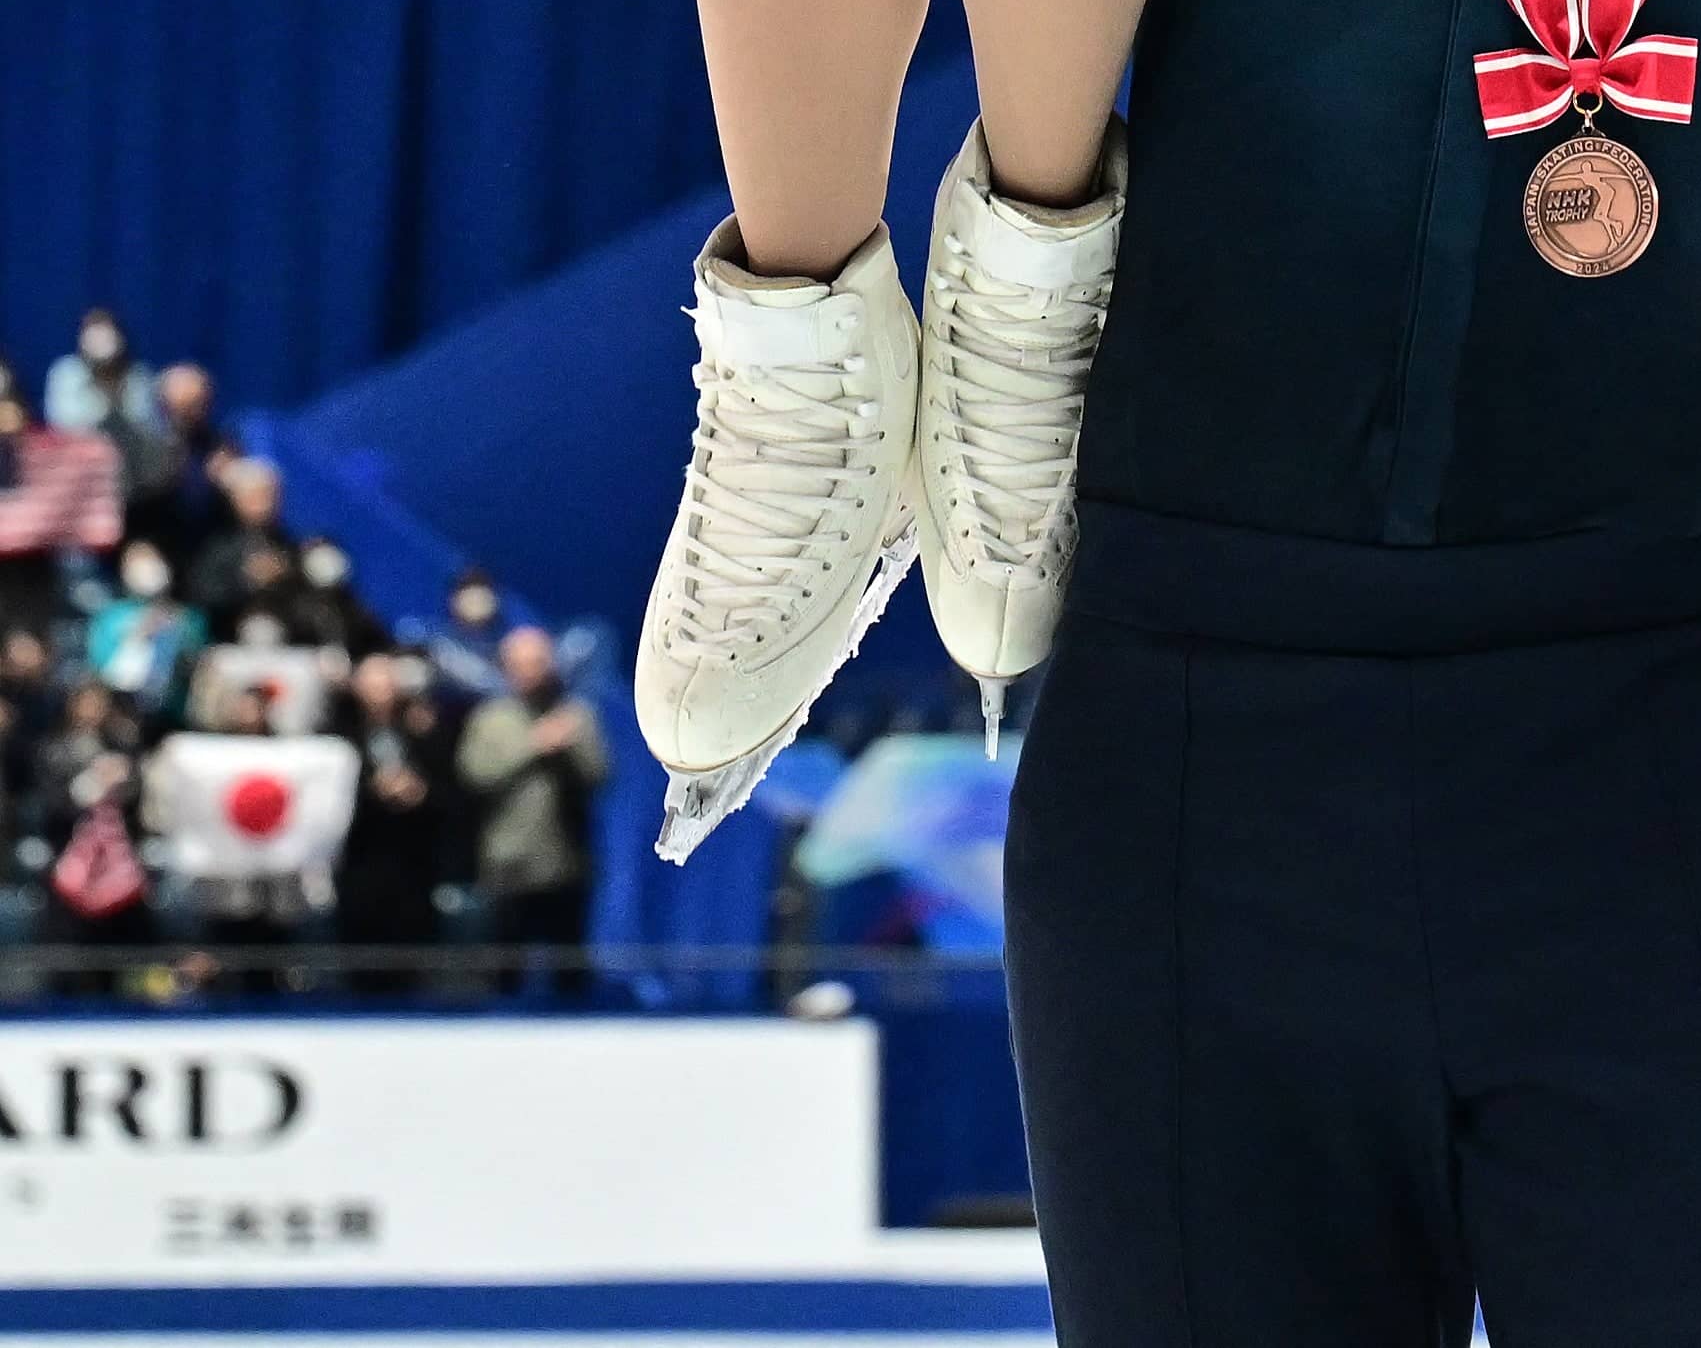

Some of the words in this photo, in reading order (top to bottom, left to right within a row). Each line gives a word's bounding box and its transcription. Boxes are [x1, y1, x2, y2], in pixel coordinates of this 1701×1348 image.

[1526, 183, 1541, 236] JAPAN
[1537, 140, 1594, 179] SKATING
[1602, 141, 1653, 225] FEDERATION
[1547, 189, 1591, 209] NHK
[1545, 207, 1589, 222] TROPHY
